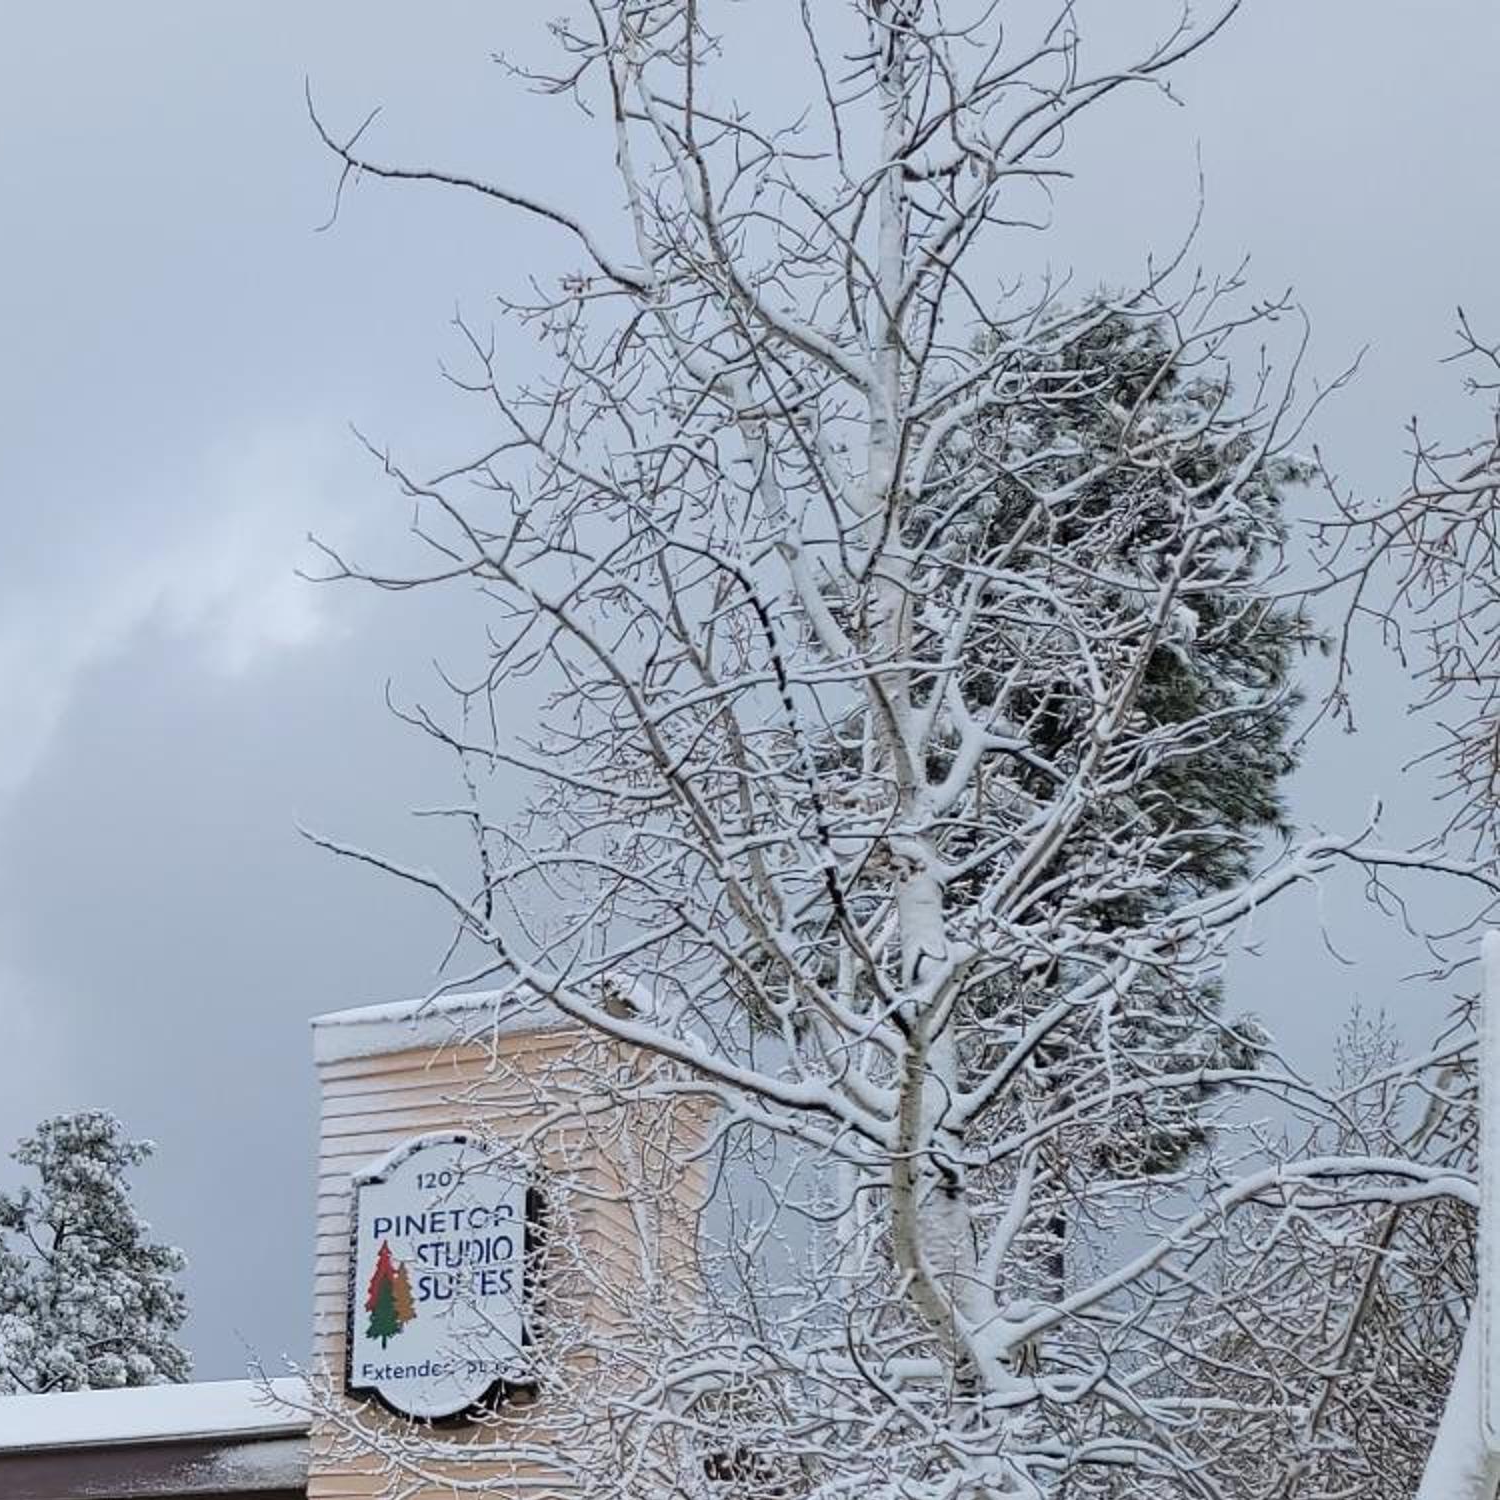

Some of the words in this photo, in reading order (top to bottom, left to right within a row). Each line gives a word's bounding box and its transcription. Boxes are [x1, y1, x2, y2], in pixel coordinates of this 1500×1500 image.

[374, 1205, 513, 1238] PINETOP
[417, 1235, 513, 1268] STUDIO
[418, 1269, 513, 1302] SUES
